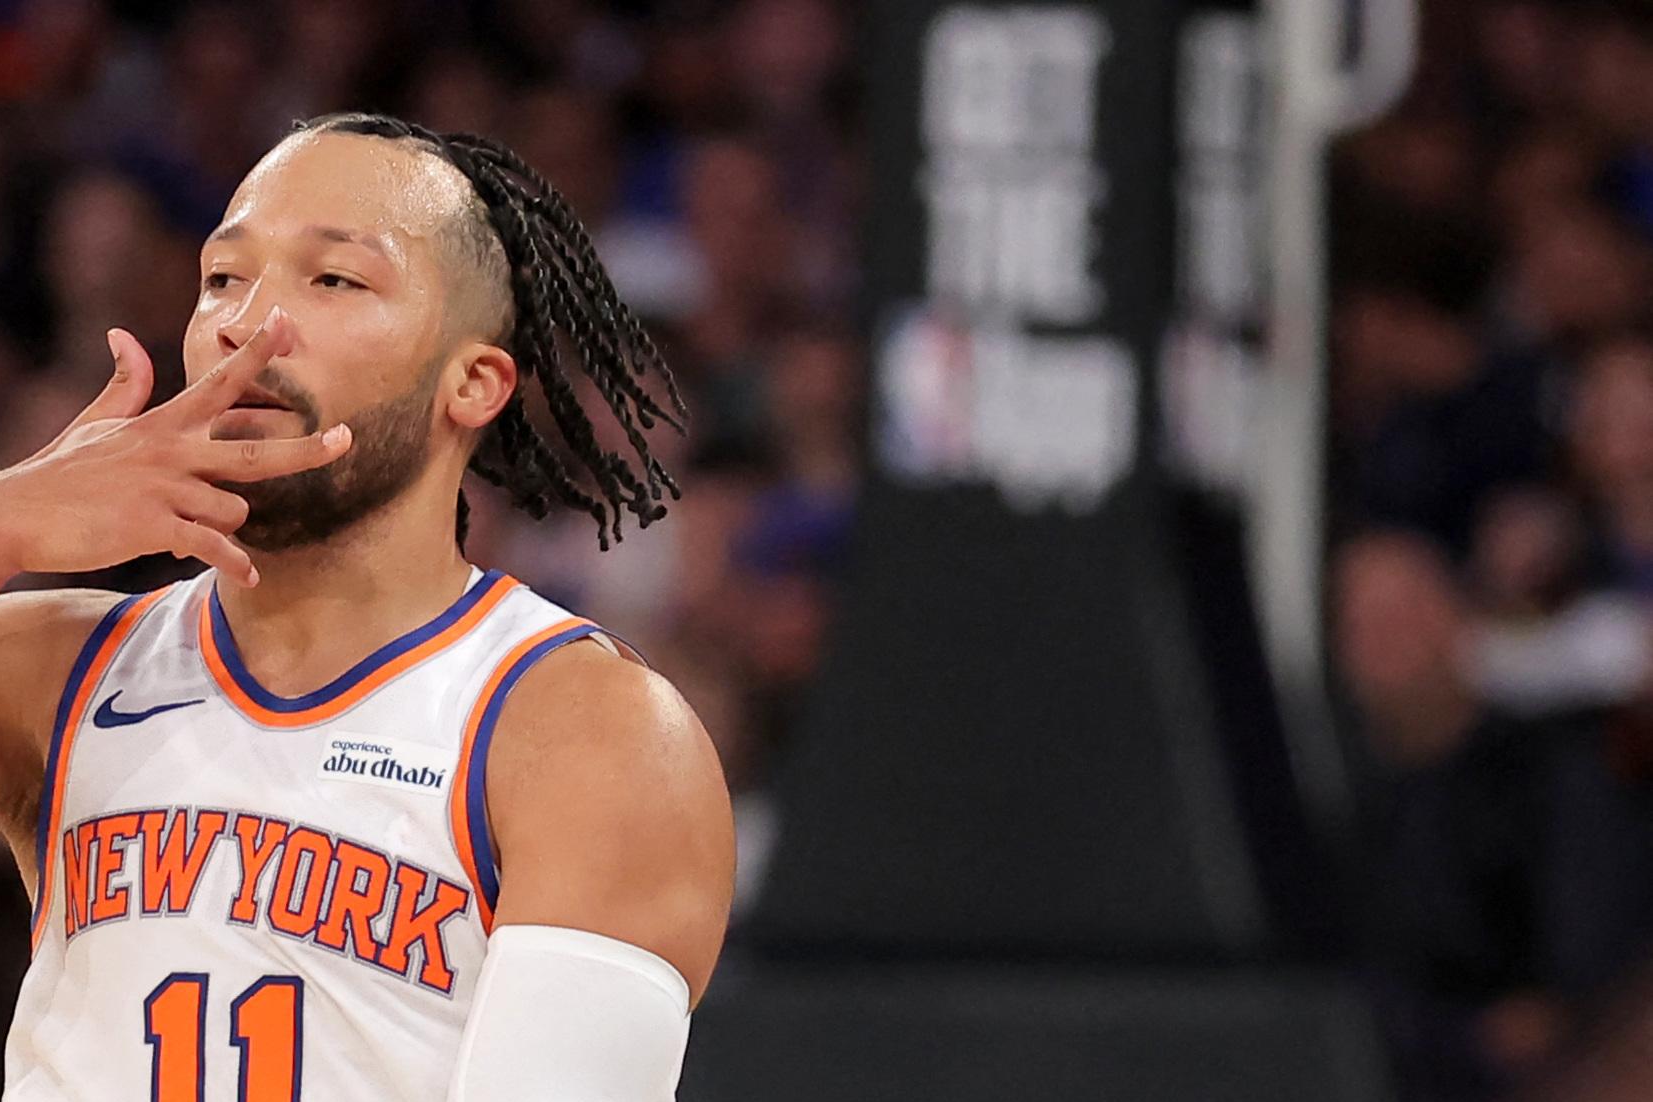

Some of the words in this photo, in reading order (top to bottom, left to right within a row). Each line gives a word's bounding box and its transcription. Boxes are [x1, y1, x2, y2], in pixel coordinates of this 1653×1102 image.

[331, 739, 393, 756] experience
[322, 752, 367, 776] abu
[370, 757, 447, 789] dhabi
[63, 804, 230, 945] NEW
[226, 807, 473, 1000] YORK
